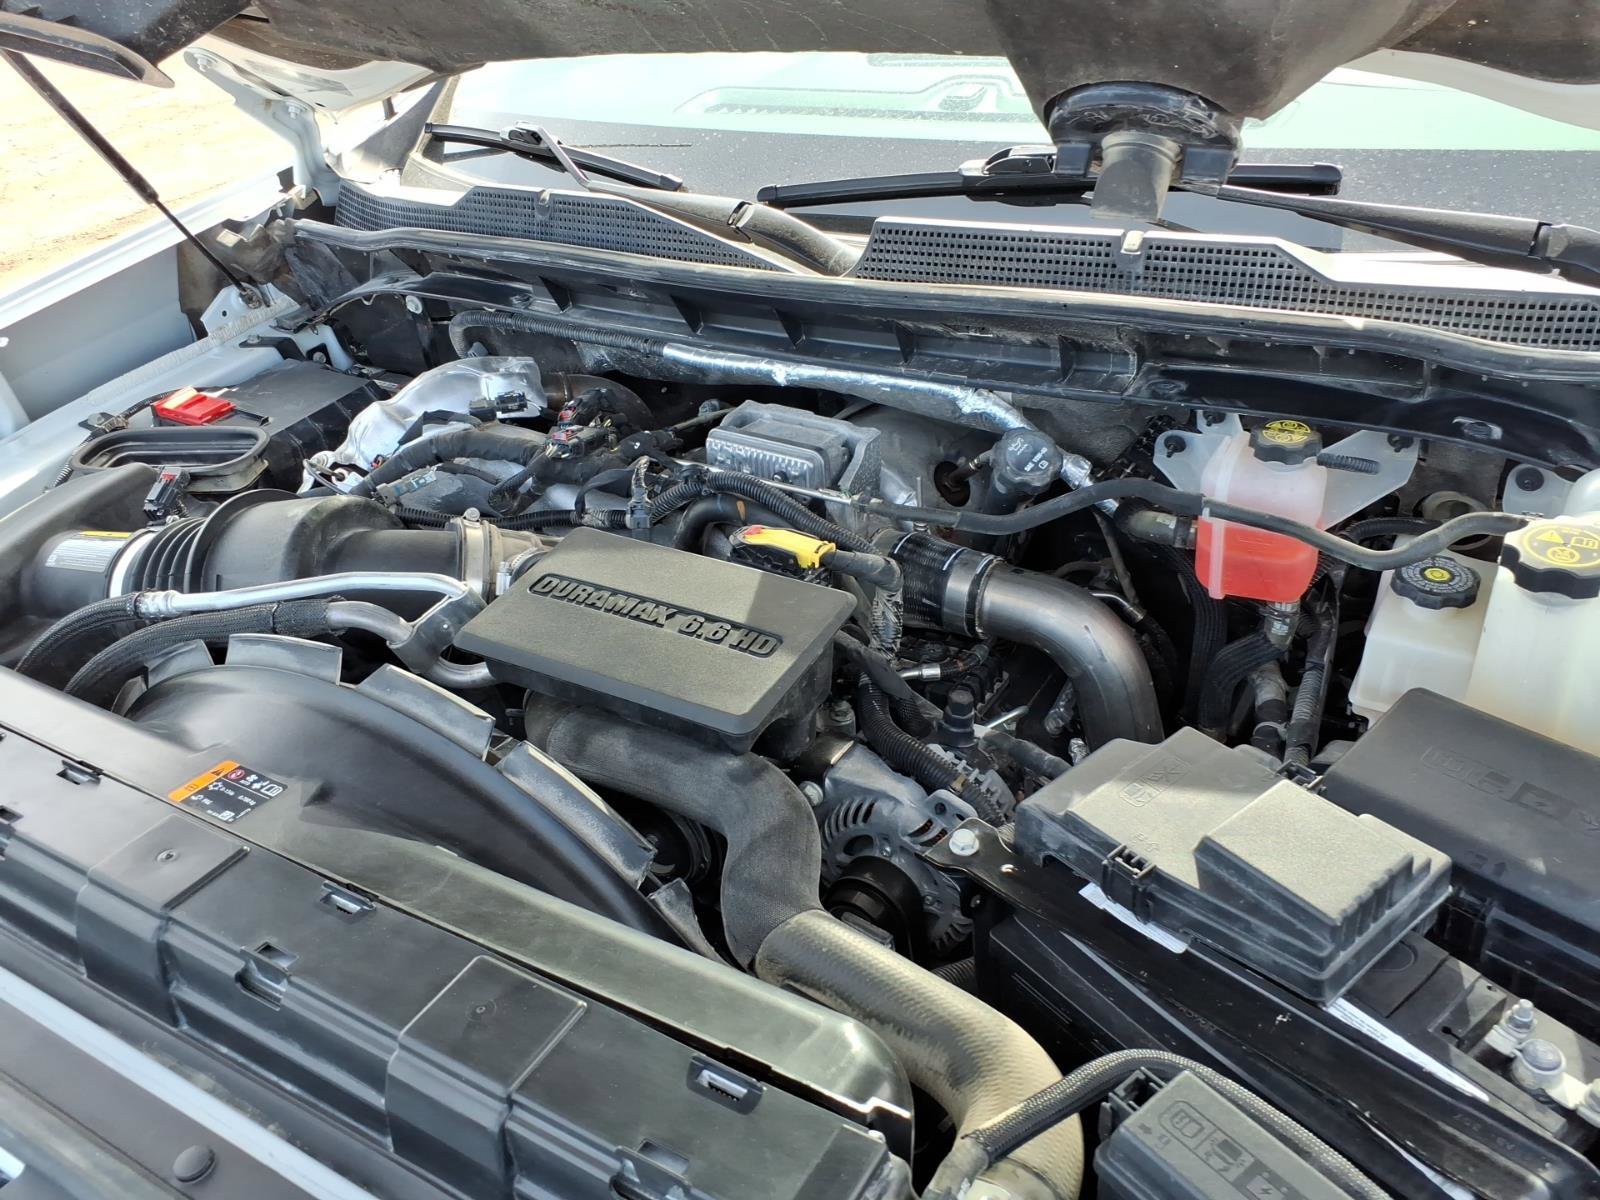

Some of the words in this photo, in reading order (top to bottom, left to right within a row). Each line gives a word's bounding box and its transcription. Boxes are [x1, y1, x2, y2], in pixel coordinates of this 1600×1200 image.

[532, 575, 678, 628] DURAMAX
[678, 614, 732, 642] 6.6
[728, 628, 779, 656] HD
